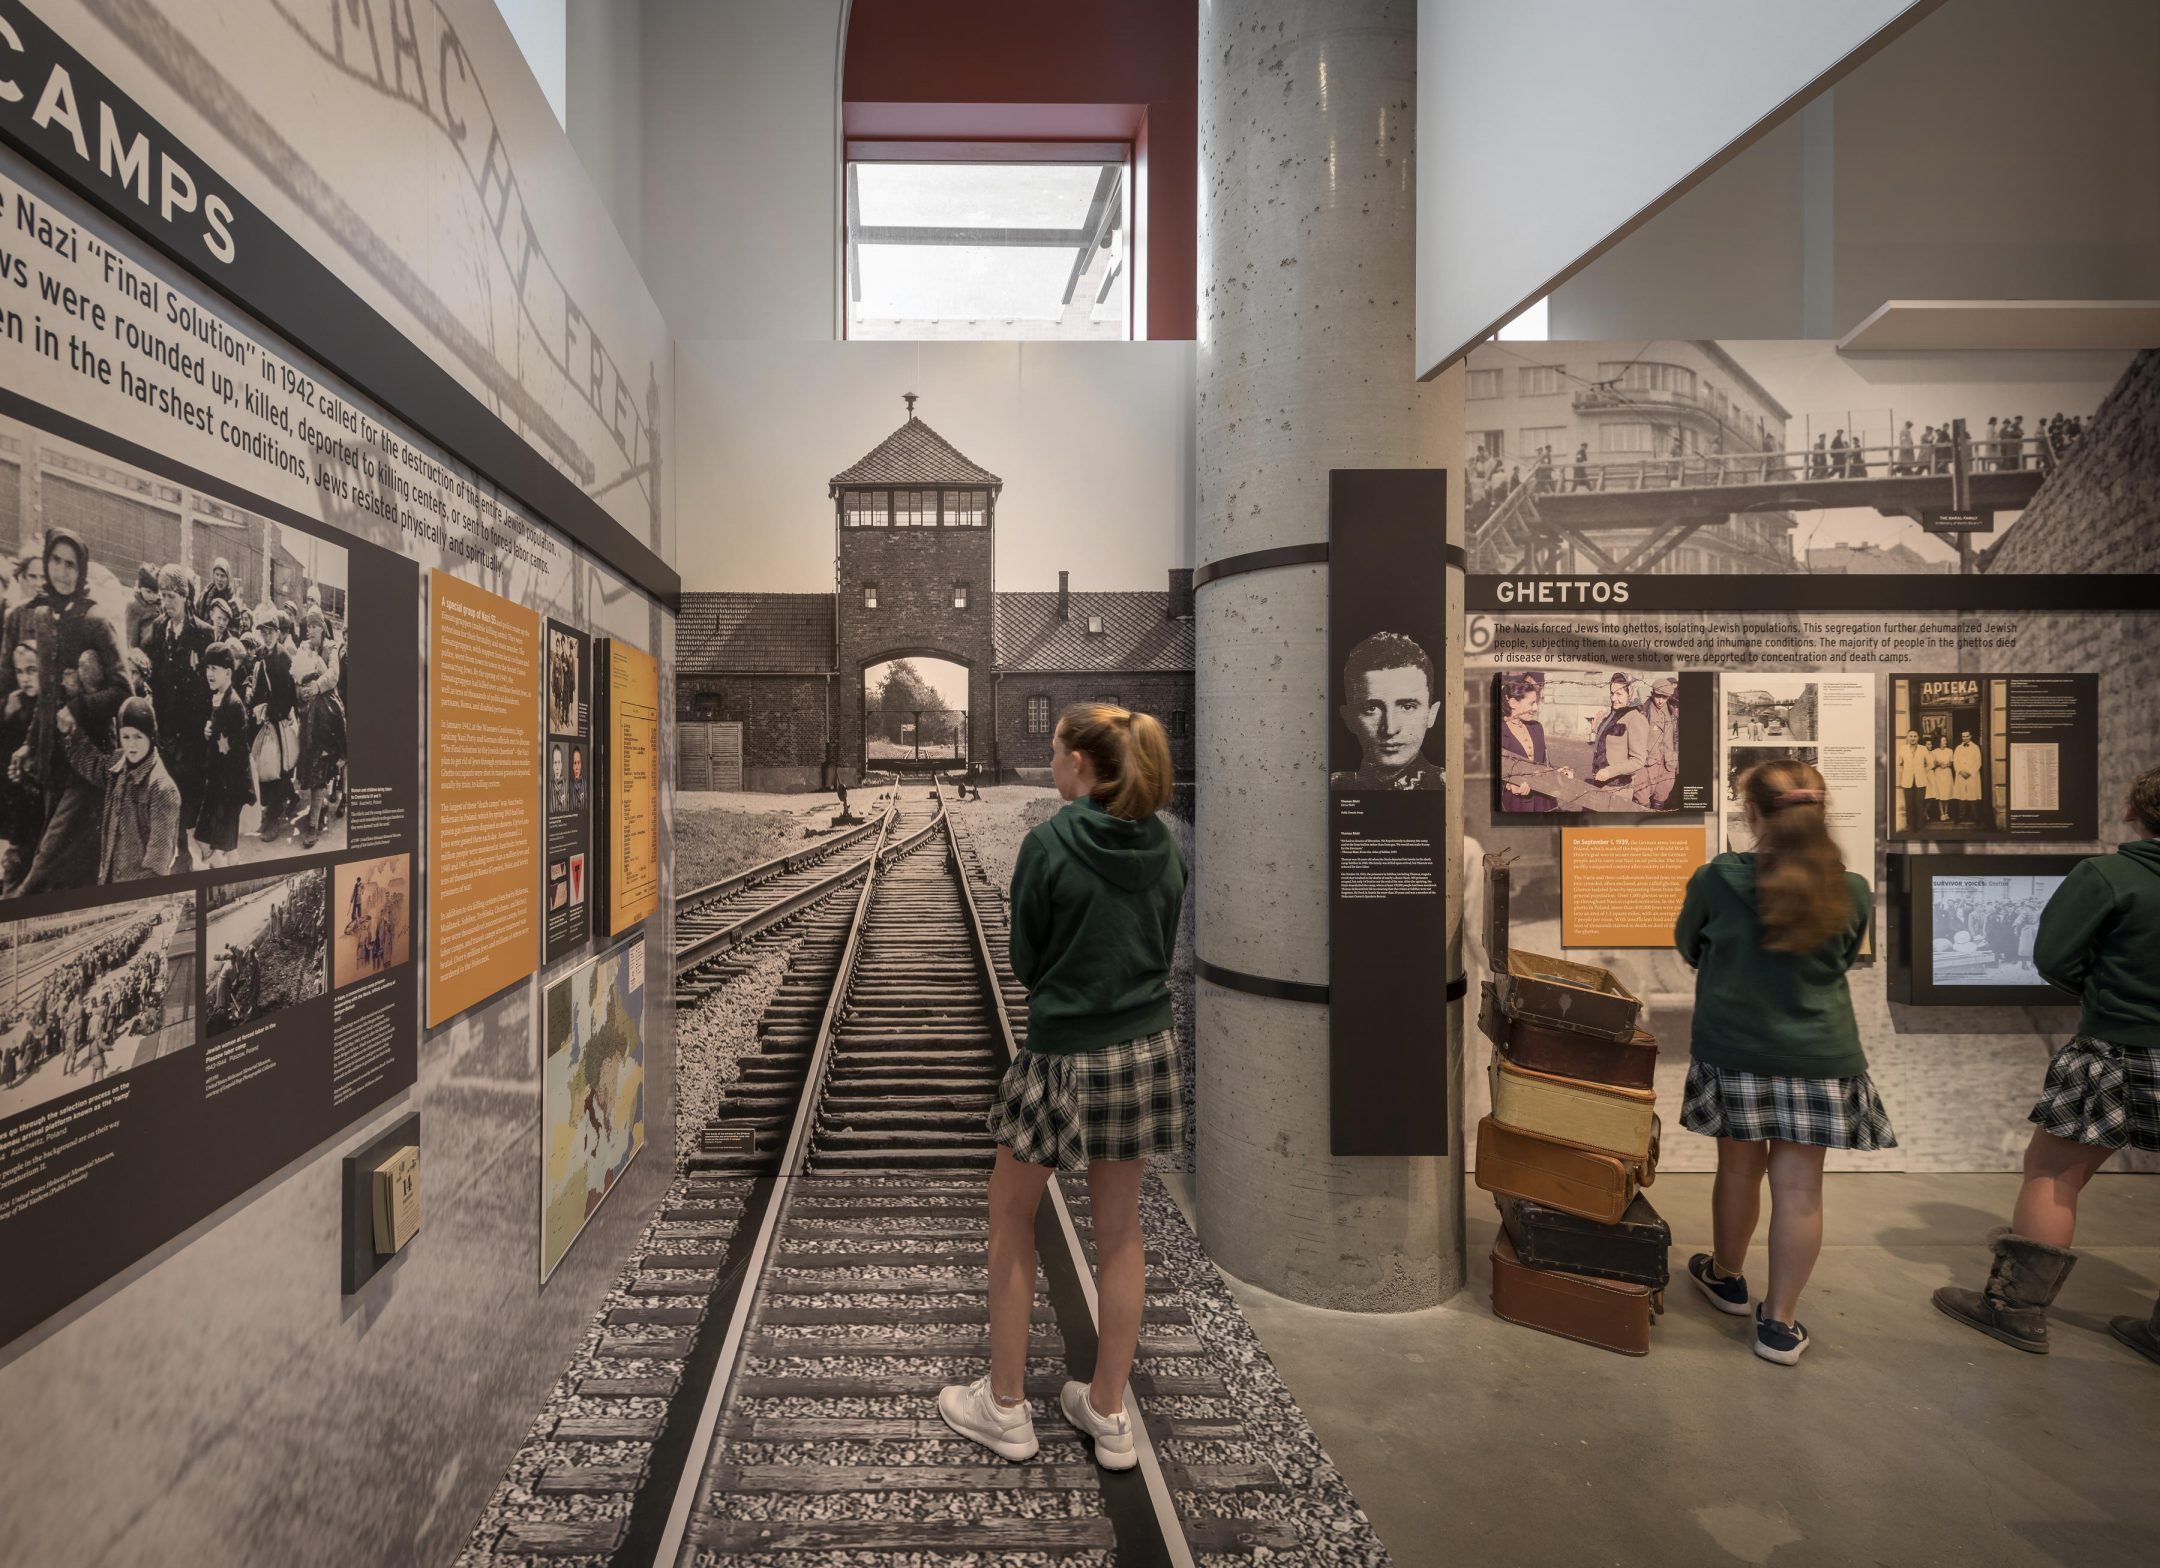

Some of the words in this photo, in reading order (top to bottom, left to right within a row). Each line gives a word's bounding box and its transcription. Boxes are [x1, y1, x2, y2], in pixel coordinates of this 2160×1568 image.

[17, 193, 77, 263] Nazi
[261, 352, 276, 384] in
[280, 365, 315, 408] 1942
[319, 395, 357, 434] called
[360, 416, 378, 445] for
[380, 429, 399, 459] the
[401, 445, 454, 494] destruction
[456, 481, 465, 500] of
[466, 484, 479, 509] the
[481, 498, 502, 522] entire
[504, 509, 525, 537] Jewish
[35, 315, 59, 361] in
[68, 335, 112, 385] the
[120, 361, 214, 435] harshest
[220, 420, 310, 485] conditions,
[314, 463, 348, 500] Jews
[352, 486, 398, 524] resisted
[401, 510, 447, 552] physically
[449, 535, 464, 556] and
[38, 271, 106, 331] were
[115, 314, 205, 386] rounded
[212, 370, 239, 408] up,
[246, 383, 293, 437] killed,
[299, 417, 359, 470] deported
[363, 451, 375, 478] to
[378, 460, 409, 502] killing
[412, 485, 449, 523] centers,
[451, 508, 461, 526] or
[462, 514, 480, 537] sent
[481, 521, 489, 541] to
[491, 525, 512, 554] forced
[513, 540, 529, 563] labor
[530, 553, 550, 575] camps.
[1496, 581, 1629, 603] GHETTOS
[1469, 615, 1490, 648] 6
[1494, 623, 1511, 634] The
[1513, 623, 1539, 634] Nazis
[1541, 623, 1572, 634] forced
[1574, 623, 1599, 634] Jews
[1601, 623, 1620, 634] into
[1622, 623, 1662, 636] ghettos,
[1664, 622, 1705, 635] isolating
[1707, 622, 1740, 633] Jewish
[1743, 622, 1801, 635] populations.
[1803, 622, 1823, 633] This
[1825, 622, 1881, 635] segregation
[1884, 622, 1917, 633] further
[1920, 622, 1982, 633] dehumanized
[1984, 622, 2017, 633] Jewish
[1494, 638, 1529, 650] people,
[1531, 638, 1580, 650] subjecting
[1582, 638, 1607, 648] them
[1609, 638, 1619, 648] to
[1622, 638, 1652, 650] overly
[1654, 637, 1695, 648] crowded
[1697, 637, 1714, 648] and
[1716, 637, 1762, 648] inhumane
[1765, 637, 1817, 648] conditions.
[1819, 637, 1836, 648] The
[1839, 637, 1878, 650] majority
[1881, 637, 1891, 648] of
[1893, 637, 1925, 650] people
[1927, 637, 1936, 648] in
[1938, 637, 1954, 648] the
[1957, 637, 1993, 650] ghettos
[1996, 637, 2016, 648] died
[1494, 652, 1505, 663] of
[1506, 652, 1542, 663] disease
[1544, 654, 1554, 663] or
[1557, 652, 1608, 665] starvation,
[1611, 654, 1635, 663] were
[1637, 652, 1661, 664] shot,
[1663, 654, 1674, 662] or
[1676, 654, 1701, 662] were
[1702, 652, 1746, 664] deported
[1748, 652, 1759, 662] to
[1761, 652, 1827, 662] concentration
[1829, 652, 1847, 662] and
[1849, 652, 1876, 662] death
[1879, 653, 1912, 664] camps.
[1923, 681, 1978, 694] APTEKA
[8, 1127, 18, 1136] go
[19, 1115, 46, 1132] through
[47, 1112, 58, 1120] the
[60, 1100, 88, 1116] selection
[88, 1089, 111, 1105] process
[112, 1086, 119, 1094] on
[120, 1082, 130, 1092] the
[22, 1128, 44, 1141] arrival
[45, 1116, 72, 1133] platform
[74, 1106, 93, 1120] known
[102, 1100, 112, 1108] the
[43, 1136, 78, 1159] background
